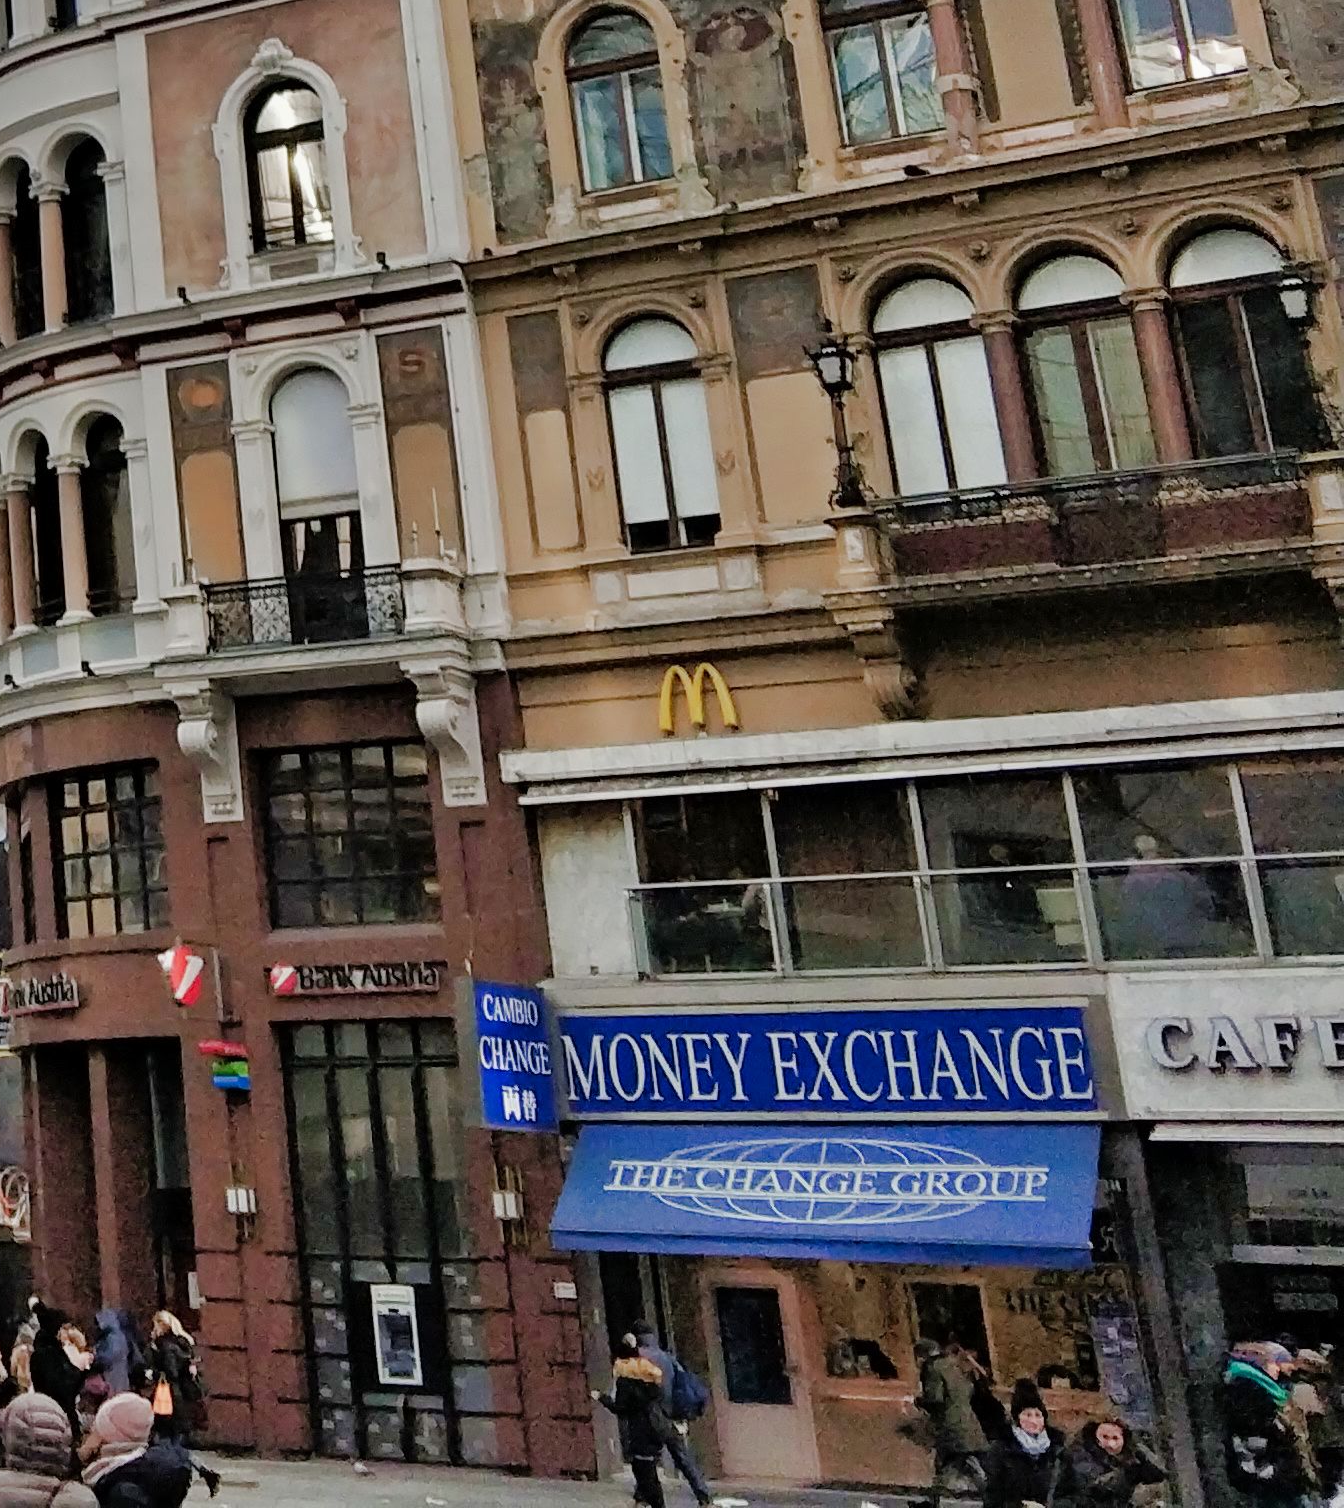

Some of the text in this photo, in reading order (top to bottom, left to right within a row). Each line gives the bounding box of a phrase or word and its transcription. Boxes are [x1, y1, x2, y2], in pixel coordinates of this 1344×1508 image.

[299, 961, 437, 990] Bank Austria
[482, 993, 539, 1027] CAMBIO
[479, 1035, 552, 1075] CHANGE
[560, 1026, 1094, 1102] MONEY EXCHANGE
[609, 1163, 1048, 1197] THE CHANGE GROUP
